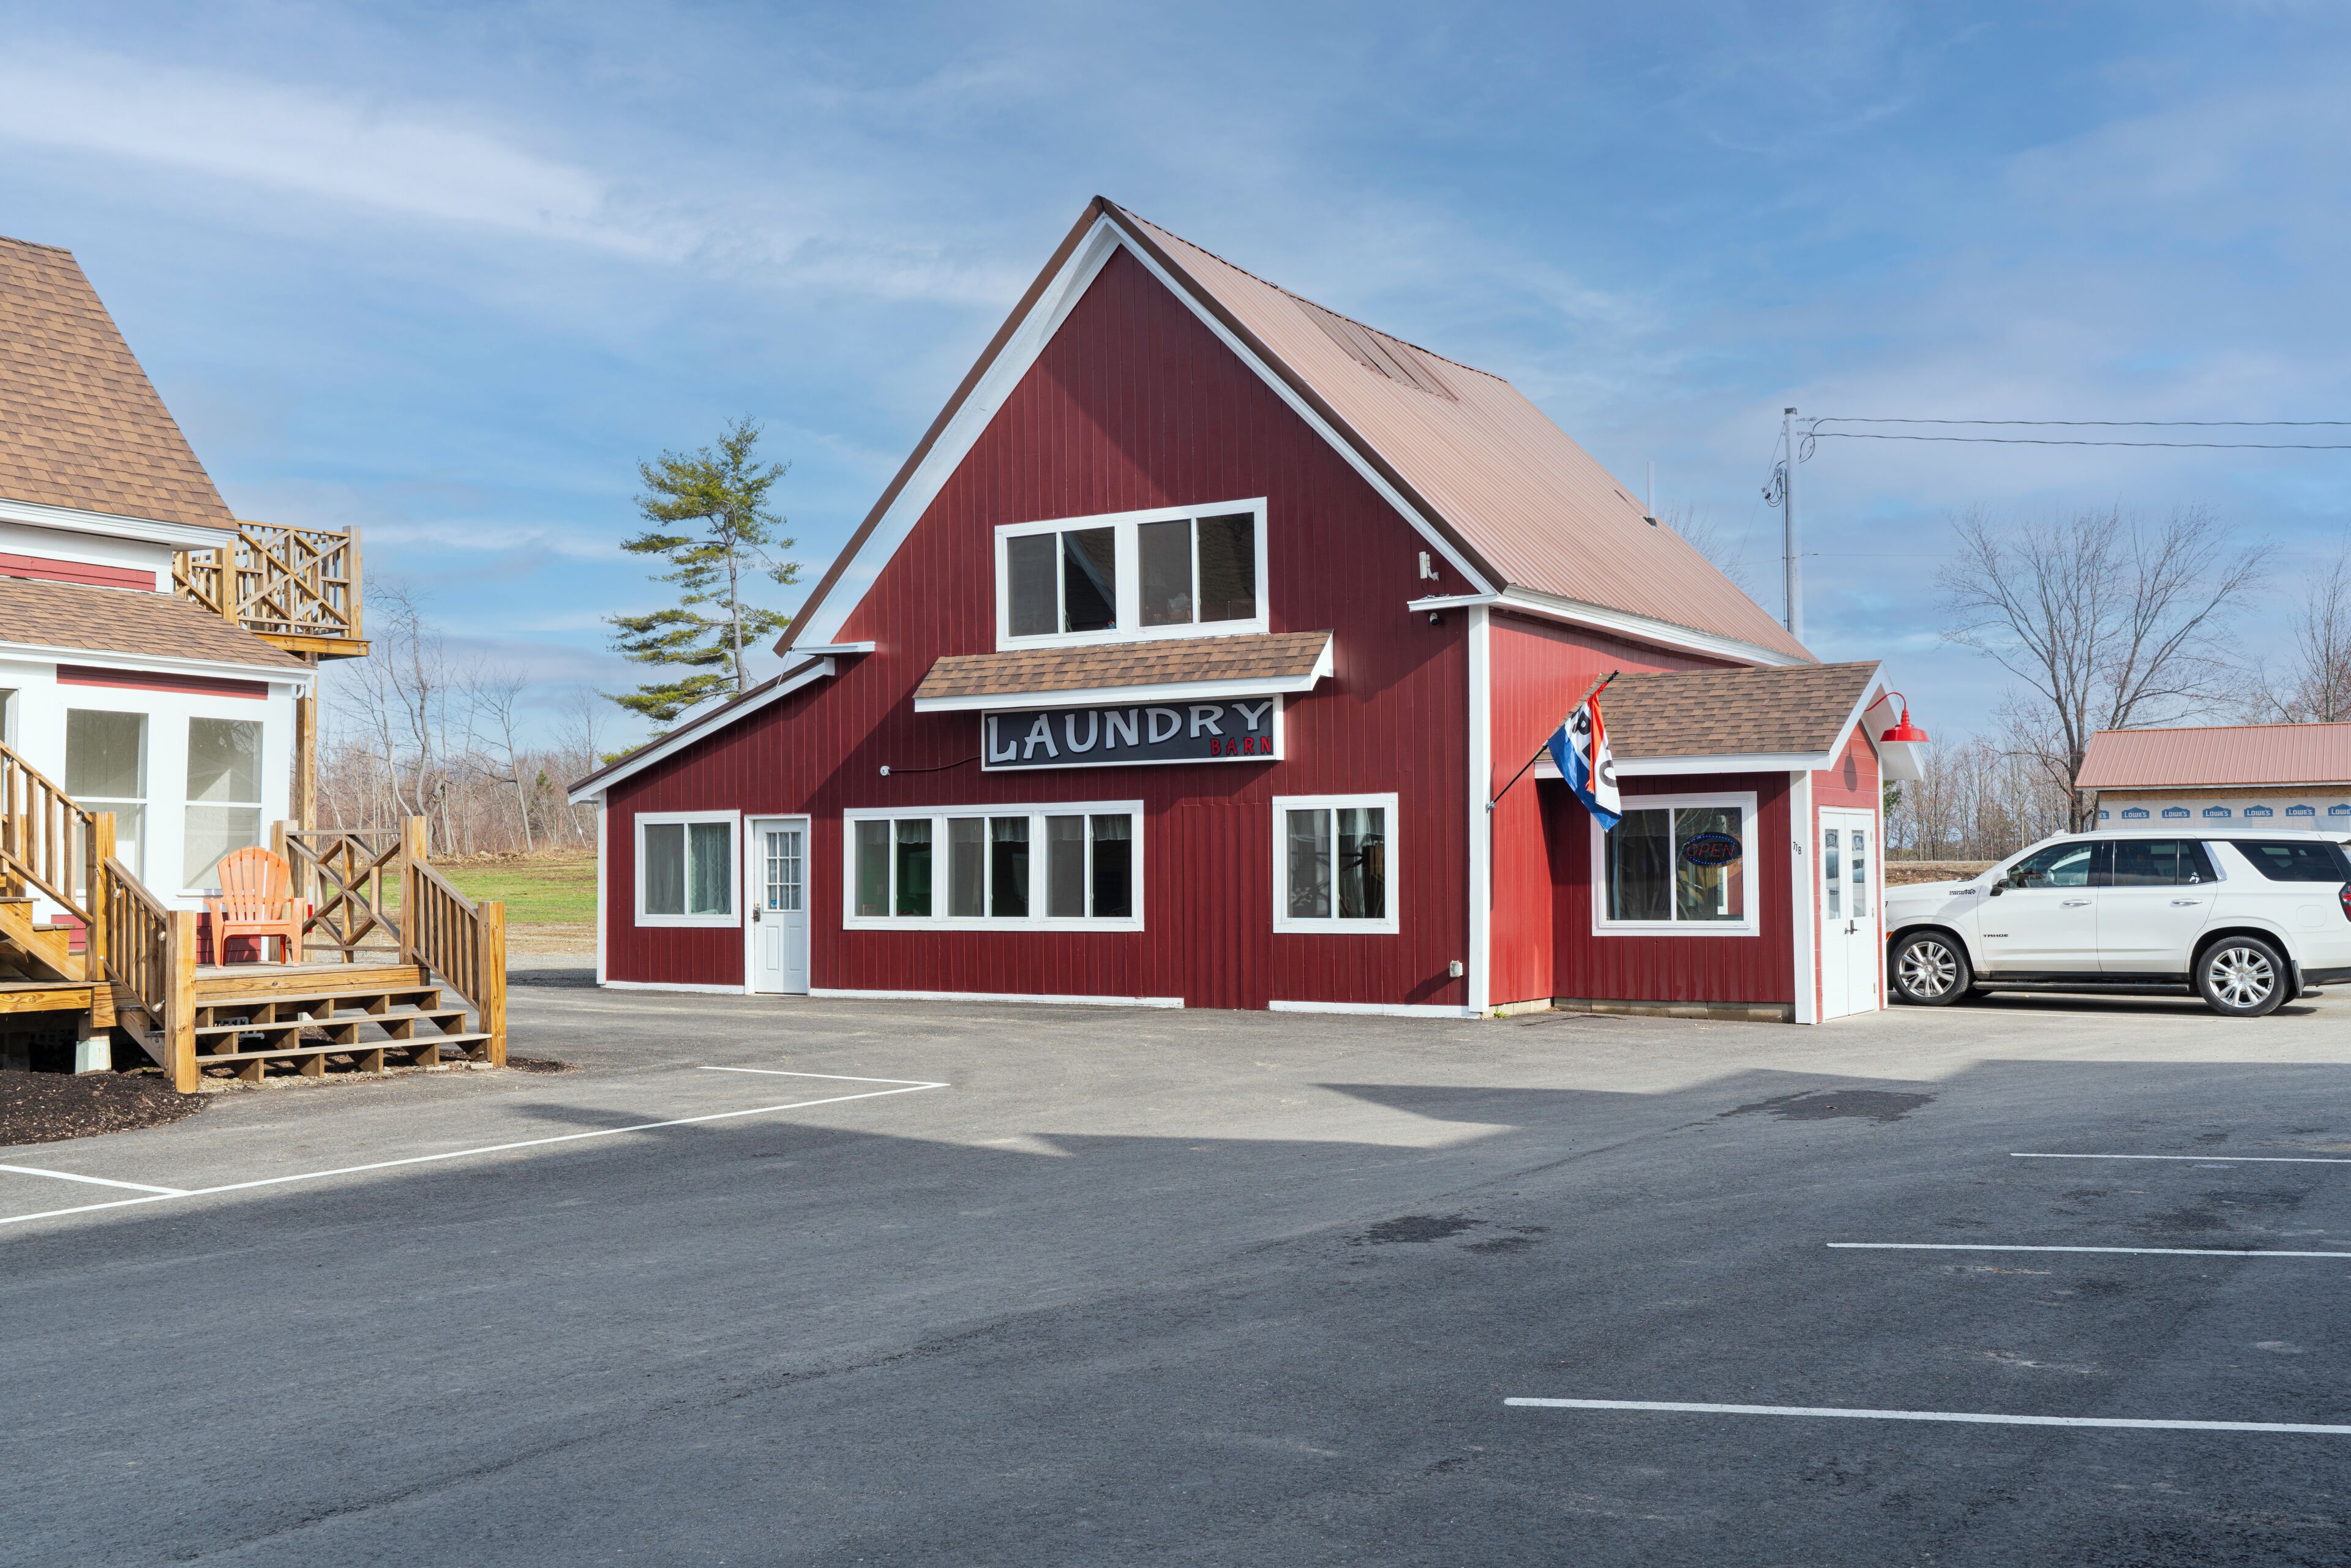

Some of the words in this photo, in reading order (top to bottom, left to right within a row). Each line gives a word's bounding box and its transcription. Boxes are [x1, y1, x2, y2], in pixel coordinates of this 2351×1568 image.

[986, 700, 1274, 764] LAUNDRY
[1210, 736, 1273, 756] BARN
[1686, 842, 1735, 858] OPEN
[1793, 841, 1802, 855] 71B
